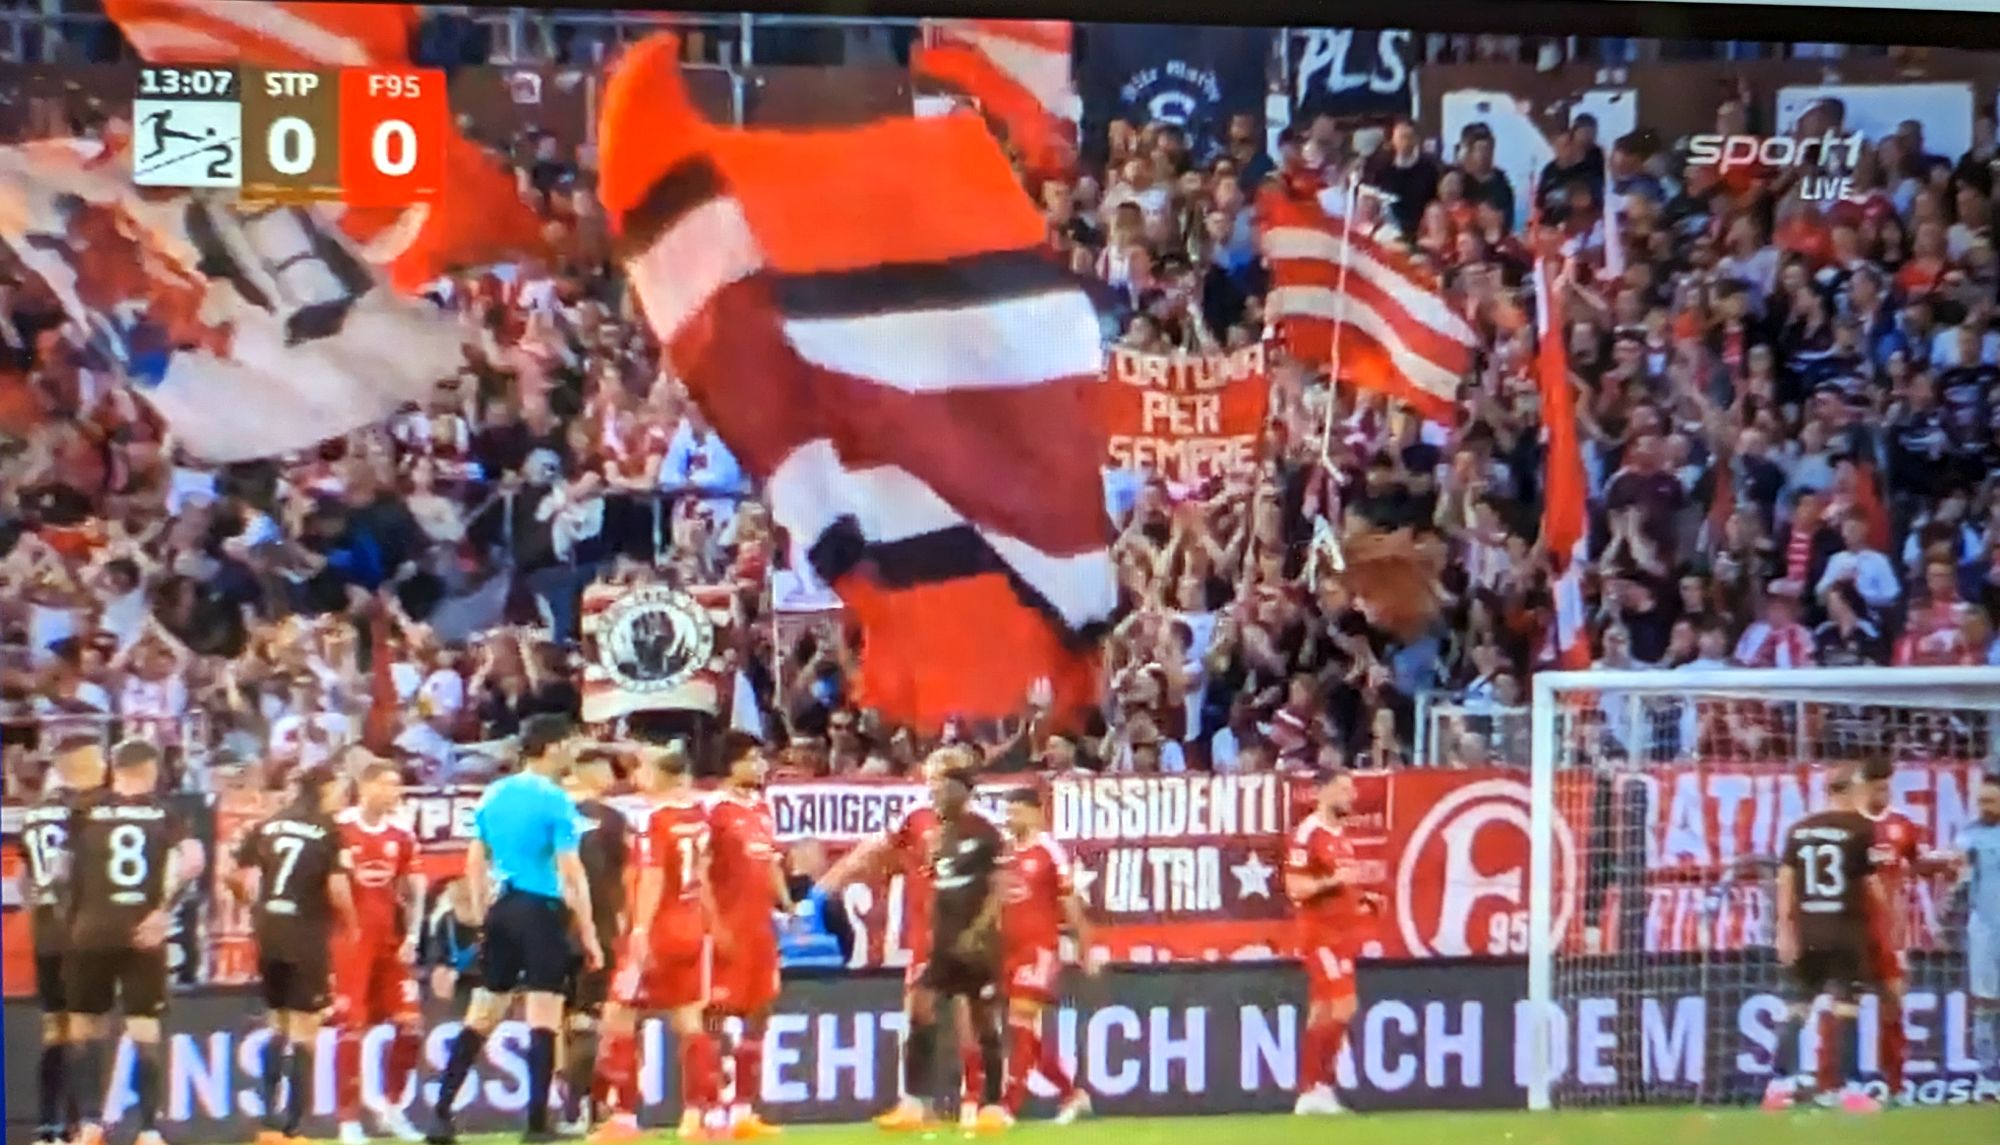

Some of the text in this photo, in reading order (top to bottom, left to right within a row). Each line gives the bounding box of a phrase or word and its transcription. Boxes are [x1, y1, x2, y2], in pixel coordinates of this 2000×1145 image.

[140, 69, 233, 95] 13:07
[265, 72, 319, 97] STP
[368, 74, 421, 98] F95
[204, 143, 234, 179] 2
[267, 116, 316, 175] 0
[372, 119, 417, 176] 0
[1686, 129, 1864, 175] sport1
[1801, 176, 1854, 200] LIVE
[1099, 343, 1265, 390] ORTUNA
[1142, 391, 1221, 434] PER
[1108, 434, 1259, 478] SEMPRE
[1052, 773, 1278, 840] DISSIDENTI
[109, 824, 149, 886] 8
[273, 836, 305, 896] 7
[1797, 843, 1847, 897] 13
[1105, 846, 1223, 912] ULTRA
[1514, 996, 1706, 1087] DEM
